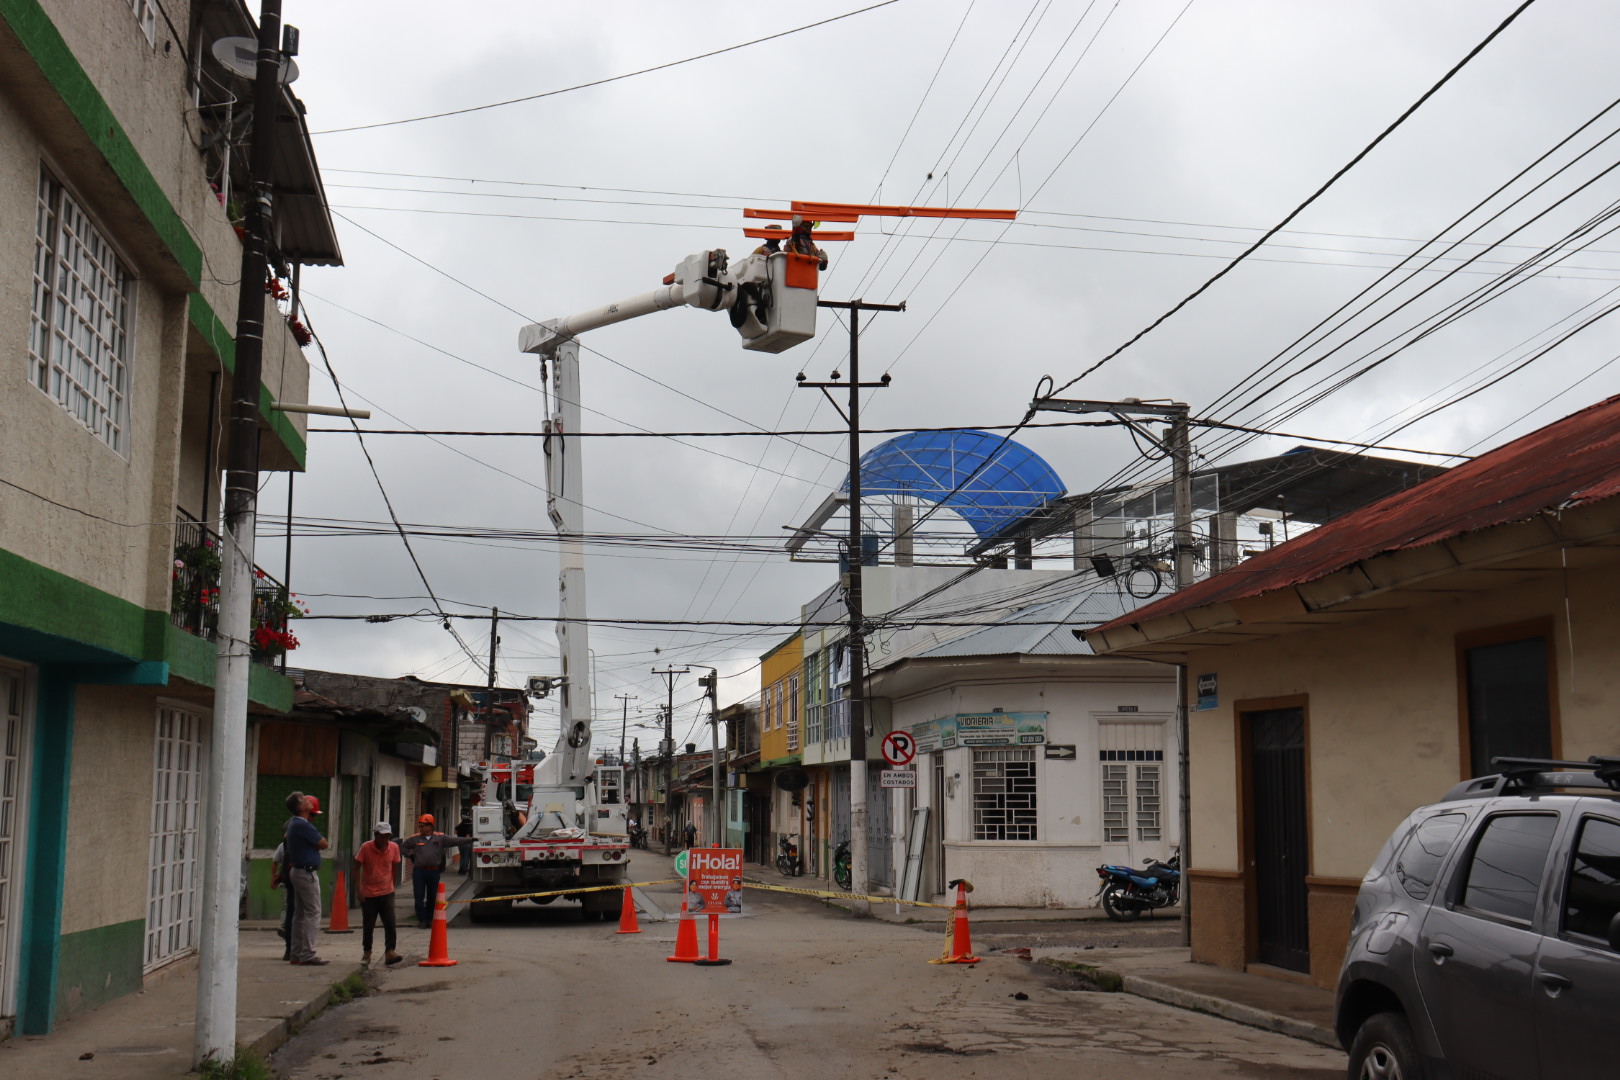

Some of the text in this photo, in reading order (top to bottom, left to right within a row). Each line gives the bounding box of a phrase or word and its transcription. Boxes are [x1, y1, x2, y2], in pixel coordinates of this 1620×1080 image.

[960, 716, 994, 726] VIDRIERIA
[892, 736, 909, 760] P
[692, 853, 740, 869] ¡Hola!
